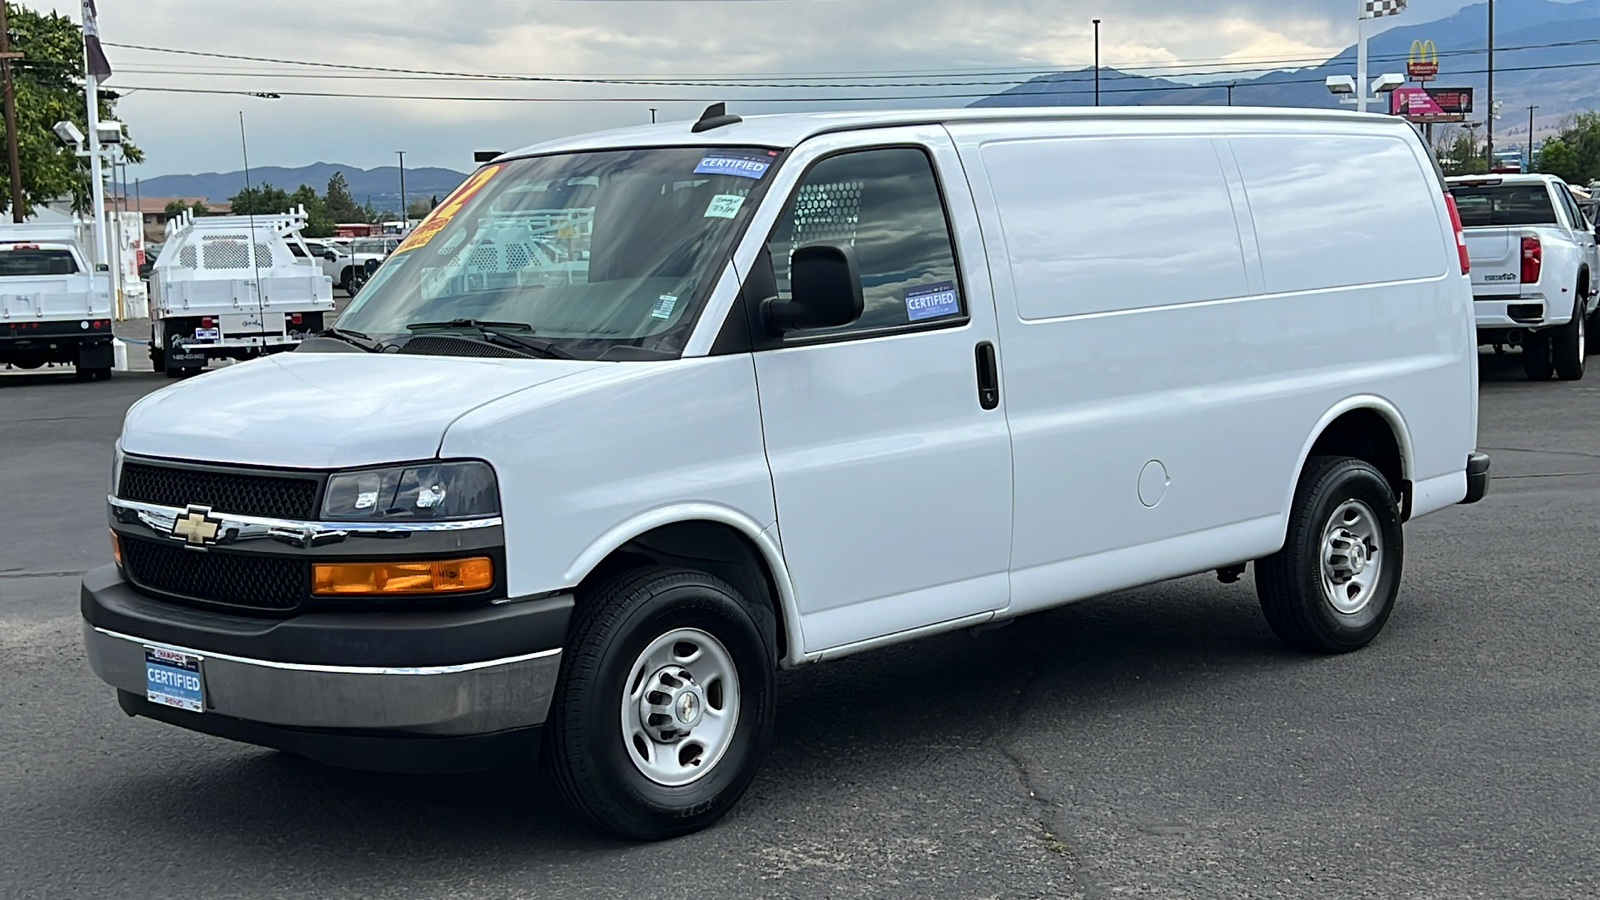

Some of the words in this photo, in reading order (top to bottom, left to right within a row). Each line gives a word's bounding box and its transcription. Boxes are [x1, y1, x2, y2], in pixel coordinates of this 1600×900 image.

[702, 158, 764, 171] CERTIFIED
[908, 292, 954, 310] CERTIFIED
[157, 649, 184, 661] CHAMPION
[147, 667, 200, 692] CERTIFIED
[165, 697, 183, 707] RENO
